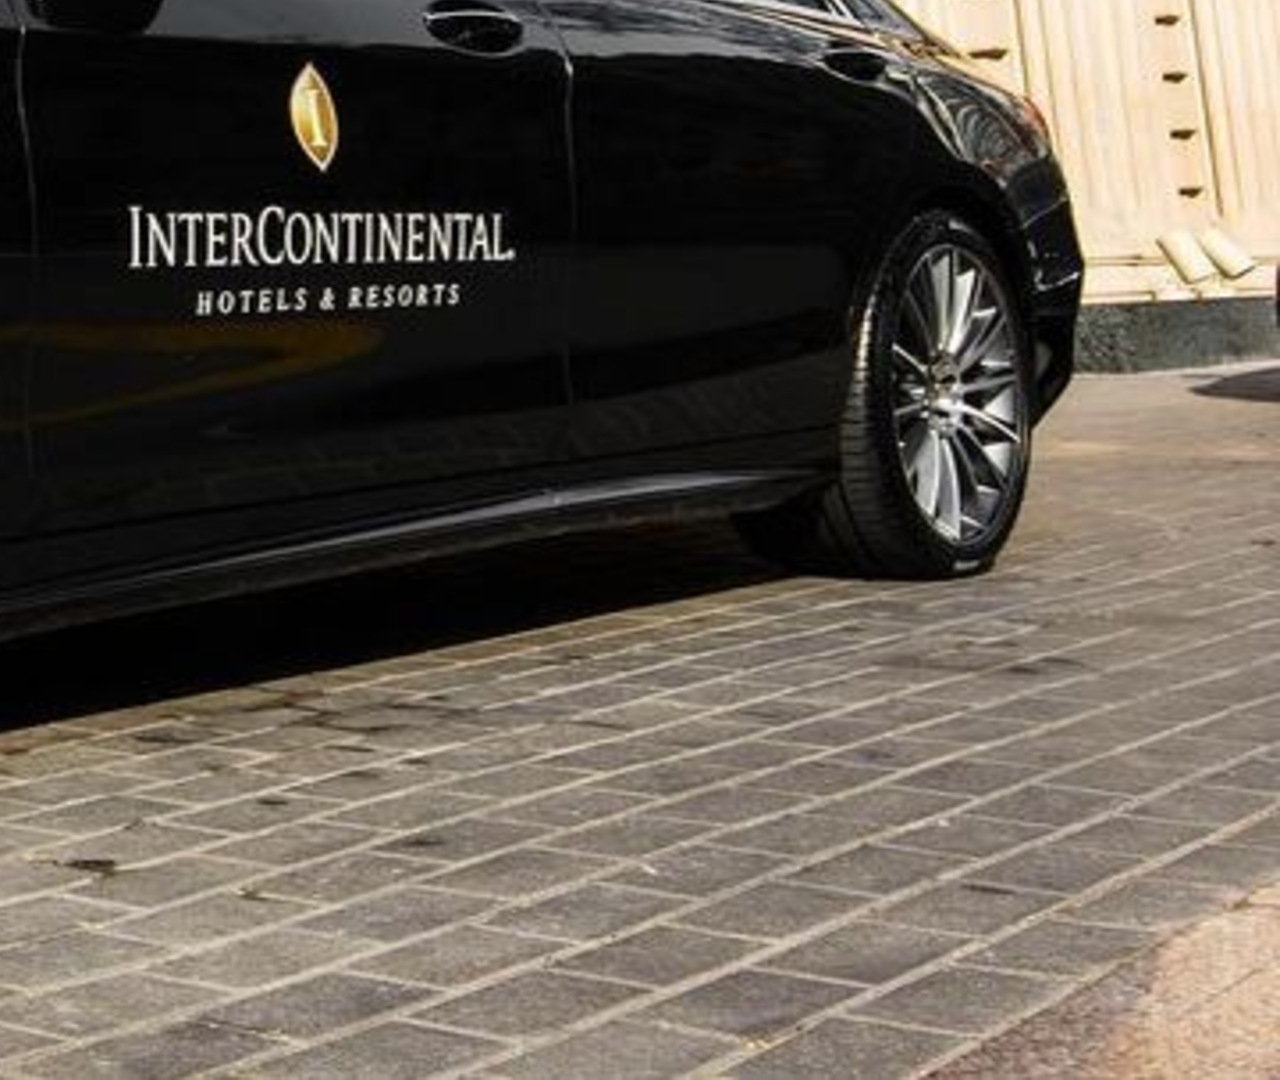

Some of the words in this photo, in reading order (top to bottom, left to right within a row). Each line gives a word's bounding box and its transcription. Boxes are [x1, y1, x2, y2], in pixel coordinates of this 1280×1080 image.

[127, 205, 512, 269] INTERCONTINENTAL
[195, 287, 308, 316] HOTELS
[319, 287, 336, 311] &
[348, 283, 461, 309] RESORTS
